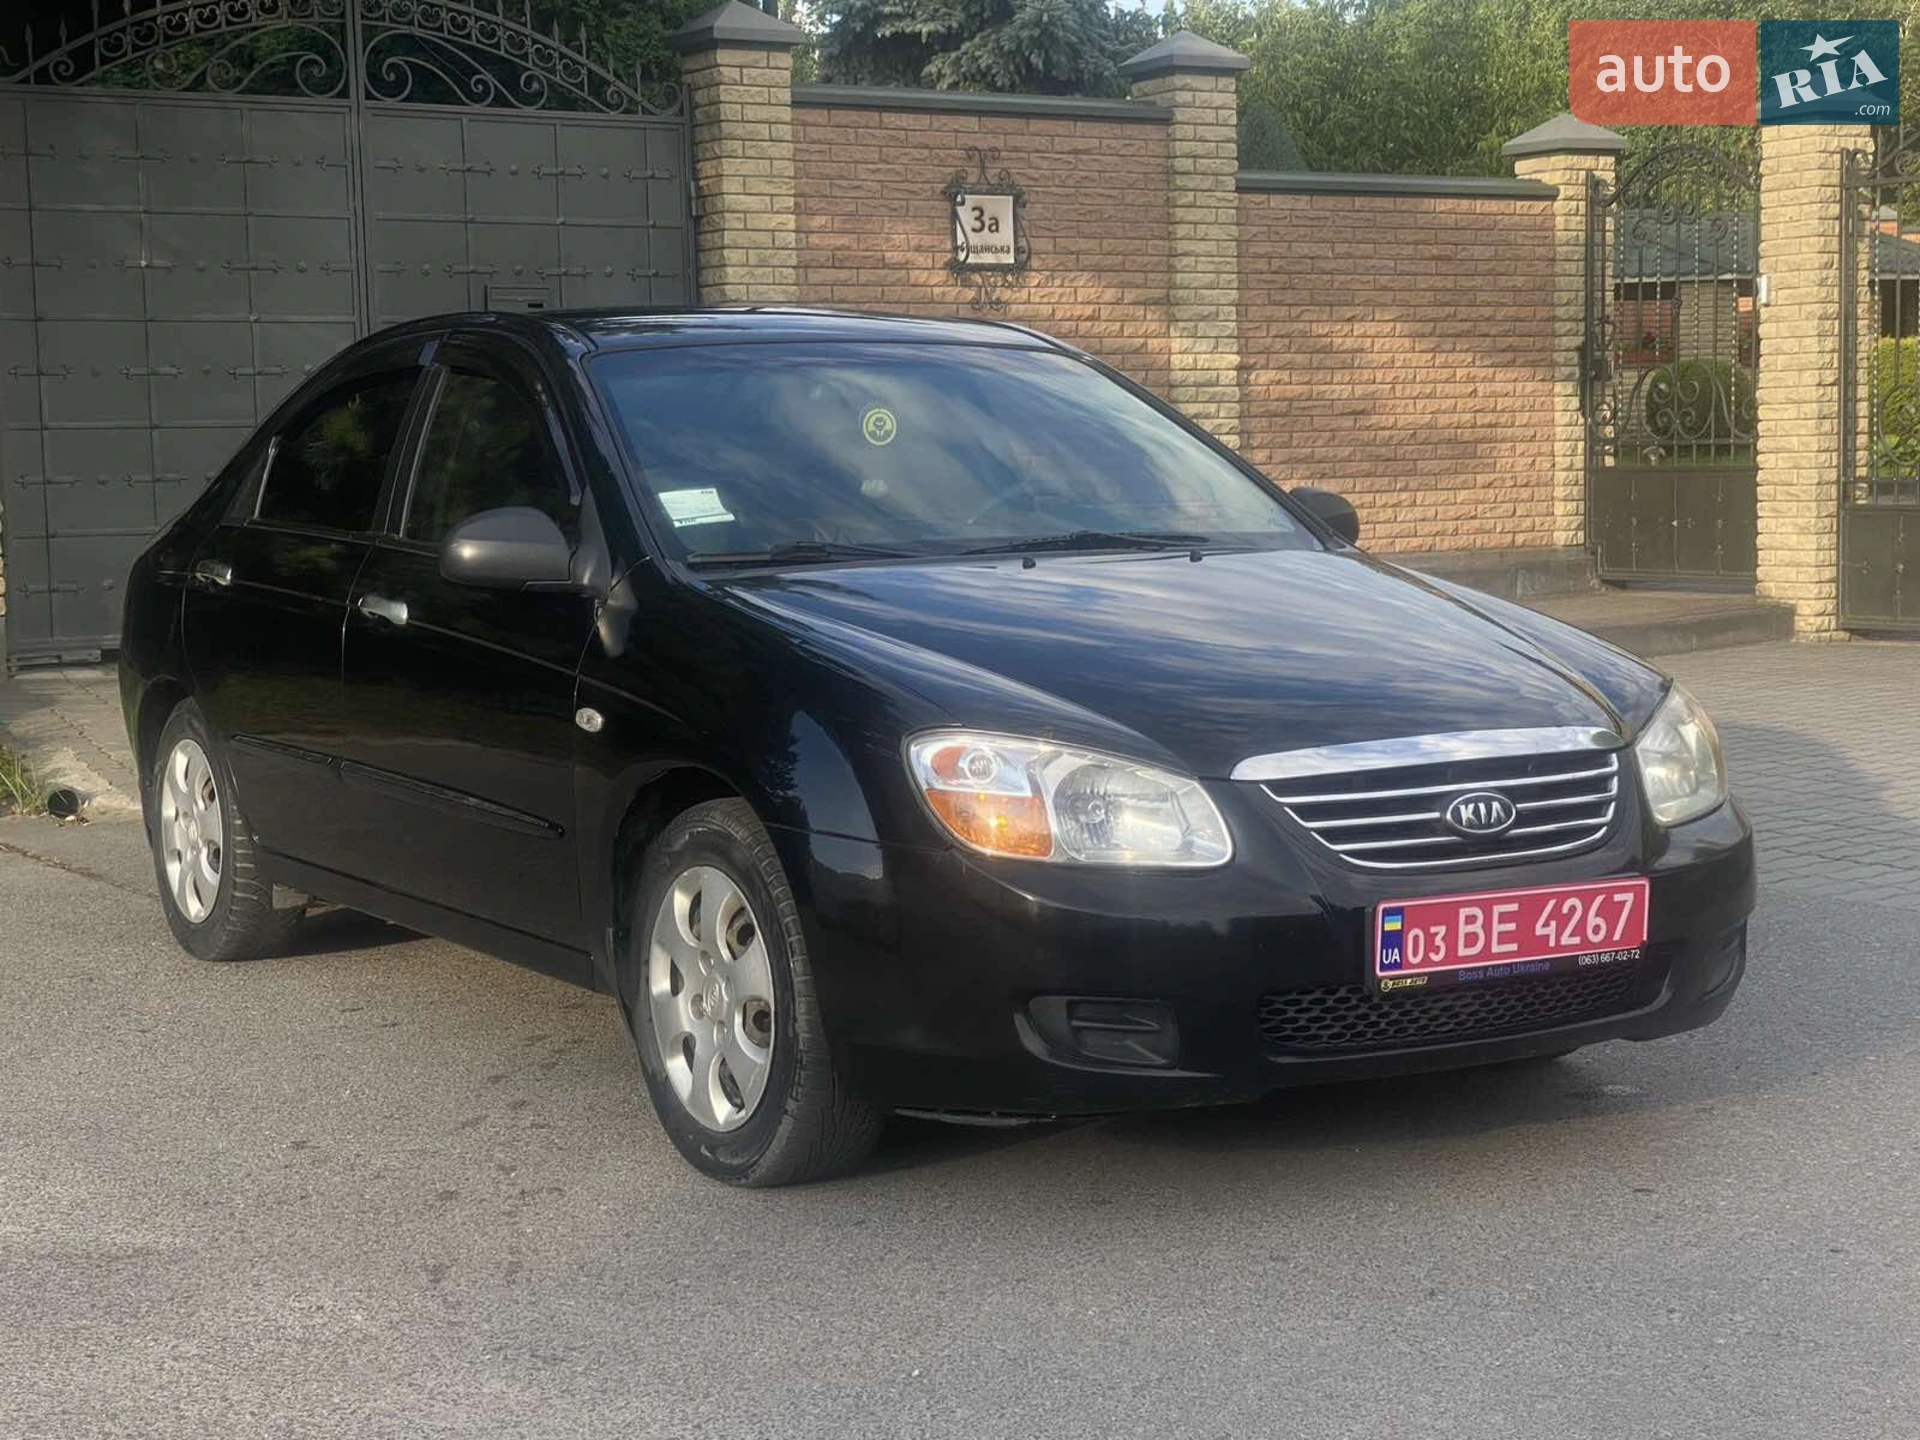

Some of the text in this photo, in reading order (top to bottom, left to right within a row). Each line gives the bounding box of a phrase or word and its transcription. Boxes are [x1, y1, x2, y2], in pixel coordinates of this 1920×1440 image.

[971, 206, 999, 233] 3а
[1458, 801, 1508, 826] KIA
[1407, 893, 1634, 964] 03 BE 4267
[1382, 948, 1401, 964] UA
[1578, 953, 1599, 966] (063)
[1459, 969, 1484, 981] Boss
[1486, 966, 1511, 977] Auto
